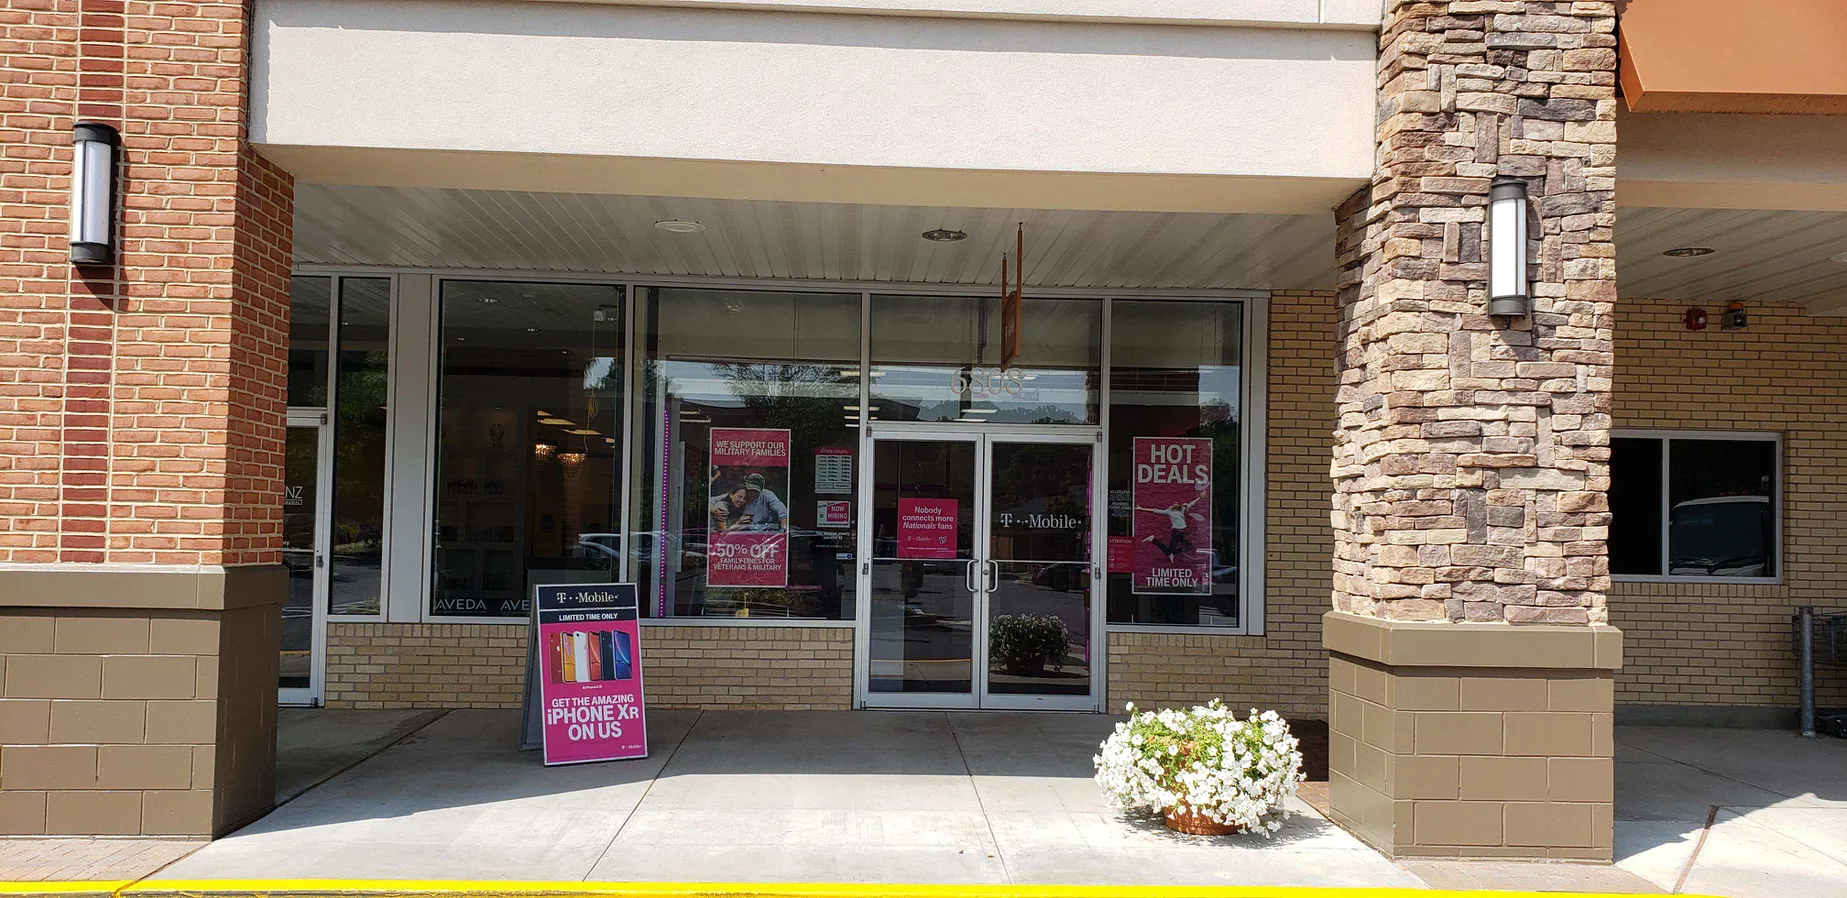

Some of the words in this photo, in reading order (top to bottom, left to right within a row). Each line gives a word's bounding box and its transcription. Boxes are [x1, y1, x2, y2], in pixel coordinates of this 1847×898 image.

[950, 367, 1023, 395] 6808
[1151, 444, 1196, 463] HOT
[1138, 464, 1209, 484] DEALS
[285, 486, 303, 498] NZ
[915, 506, 942, 515] Nobody
[717, 544, 747, 558] 50%
[750, 544, 779, 558] OFF
[1152, 568, 1192, 577] LIMITED
[1146, 577, 1170, 586] TIME
[1172, 578, 1198, 587] ONLY
[435, 599, 487, 610] AVEDA
[501, 600, 530, 610] AVE
[552, 698, 570, 707] GET
[572, 697, 590, 706] THE
[592, 694, 634, 705] AMAZING
[547, 705, 614, 725] iPHONE
[568, 723, 594, 740] ON
[598, 721, 622, 738] US
